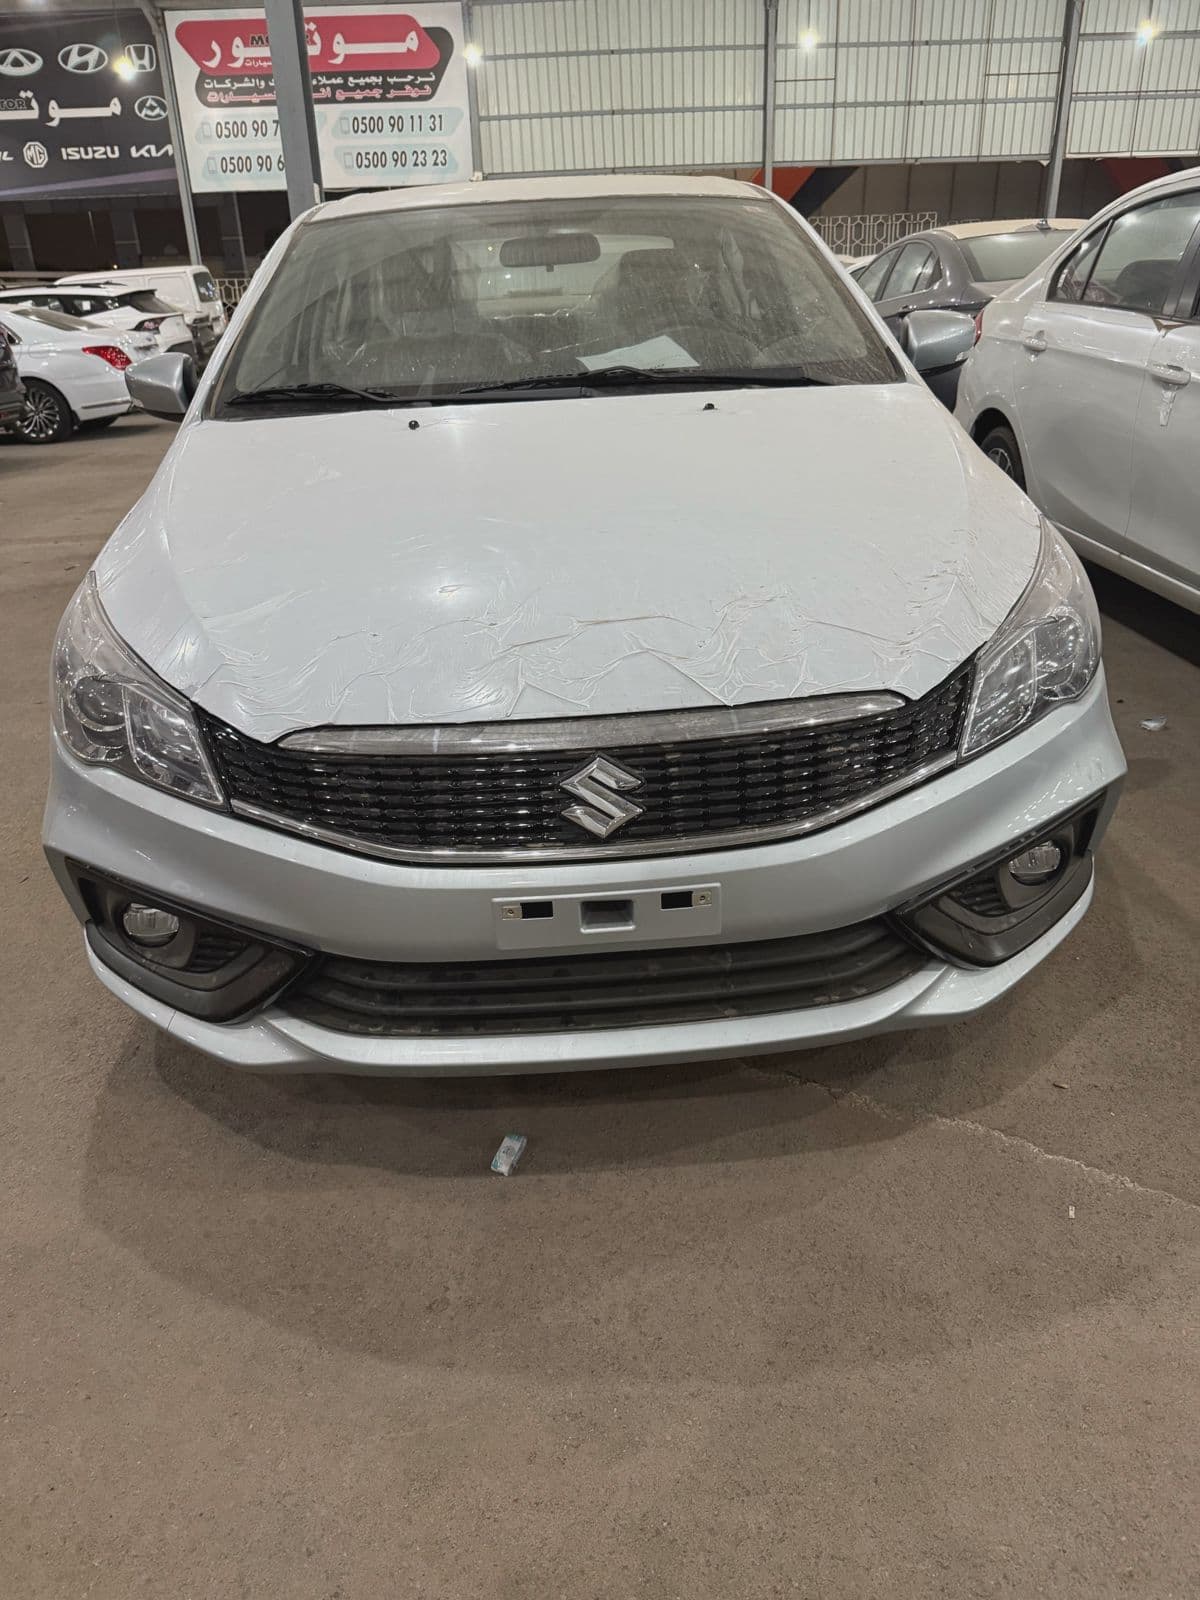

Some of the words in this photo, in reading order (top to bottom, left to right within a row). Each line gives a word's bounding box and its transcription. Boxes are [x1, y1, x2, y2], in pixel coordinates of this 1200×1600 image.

[203, 77, 265, 89] والشركات
[312, 75, 344, 85] عملاء
[348, 75, 382, 87] بجميع
[215, 121, 248, 138] 0500
[252, 120, 268, 137] 90
[272, 120, 280, 136] 7
[352, 116, 384, 134] 0500
[388, 115, 404, 132] 90
[410, 115, 422, 132] 11
[429, 114, 443, 131] 31
[25, 144, 46, 166] MG
[61, 146, 120, 160] ISUZU
[356, 151, 387, 168] 0500
[392, 151, 407, 167] 90
[412, 150, 427, 167] 23
[431, 149, 447, 166] 23
[220, 155, 252, 173] 0500
[256, 155, 272, 172] 90
[277, 155, 285, 172] 6
